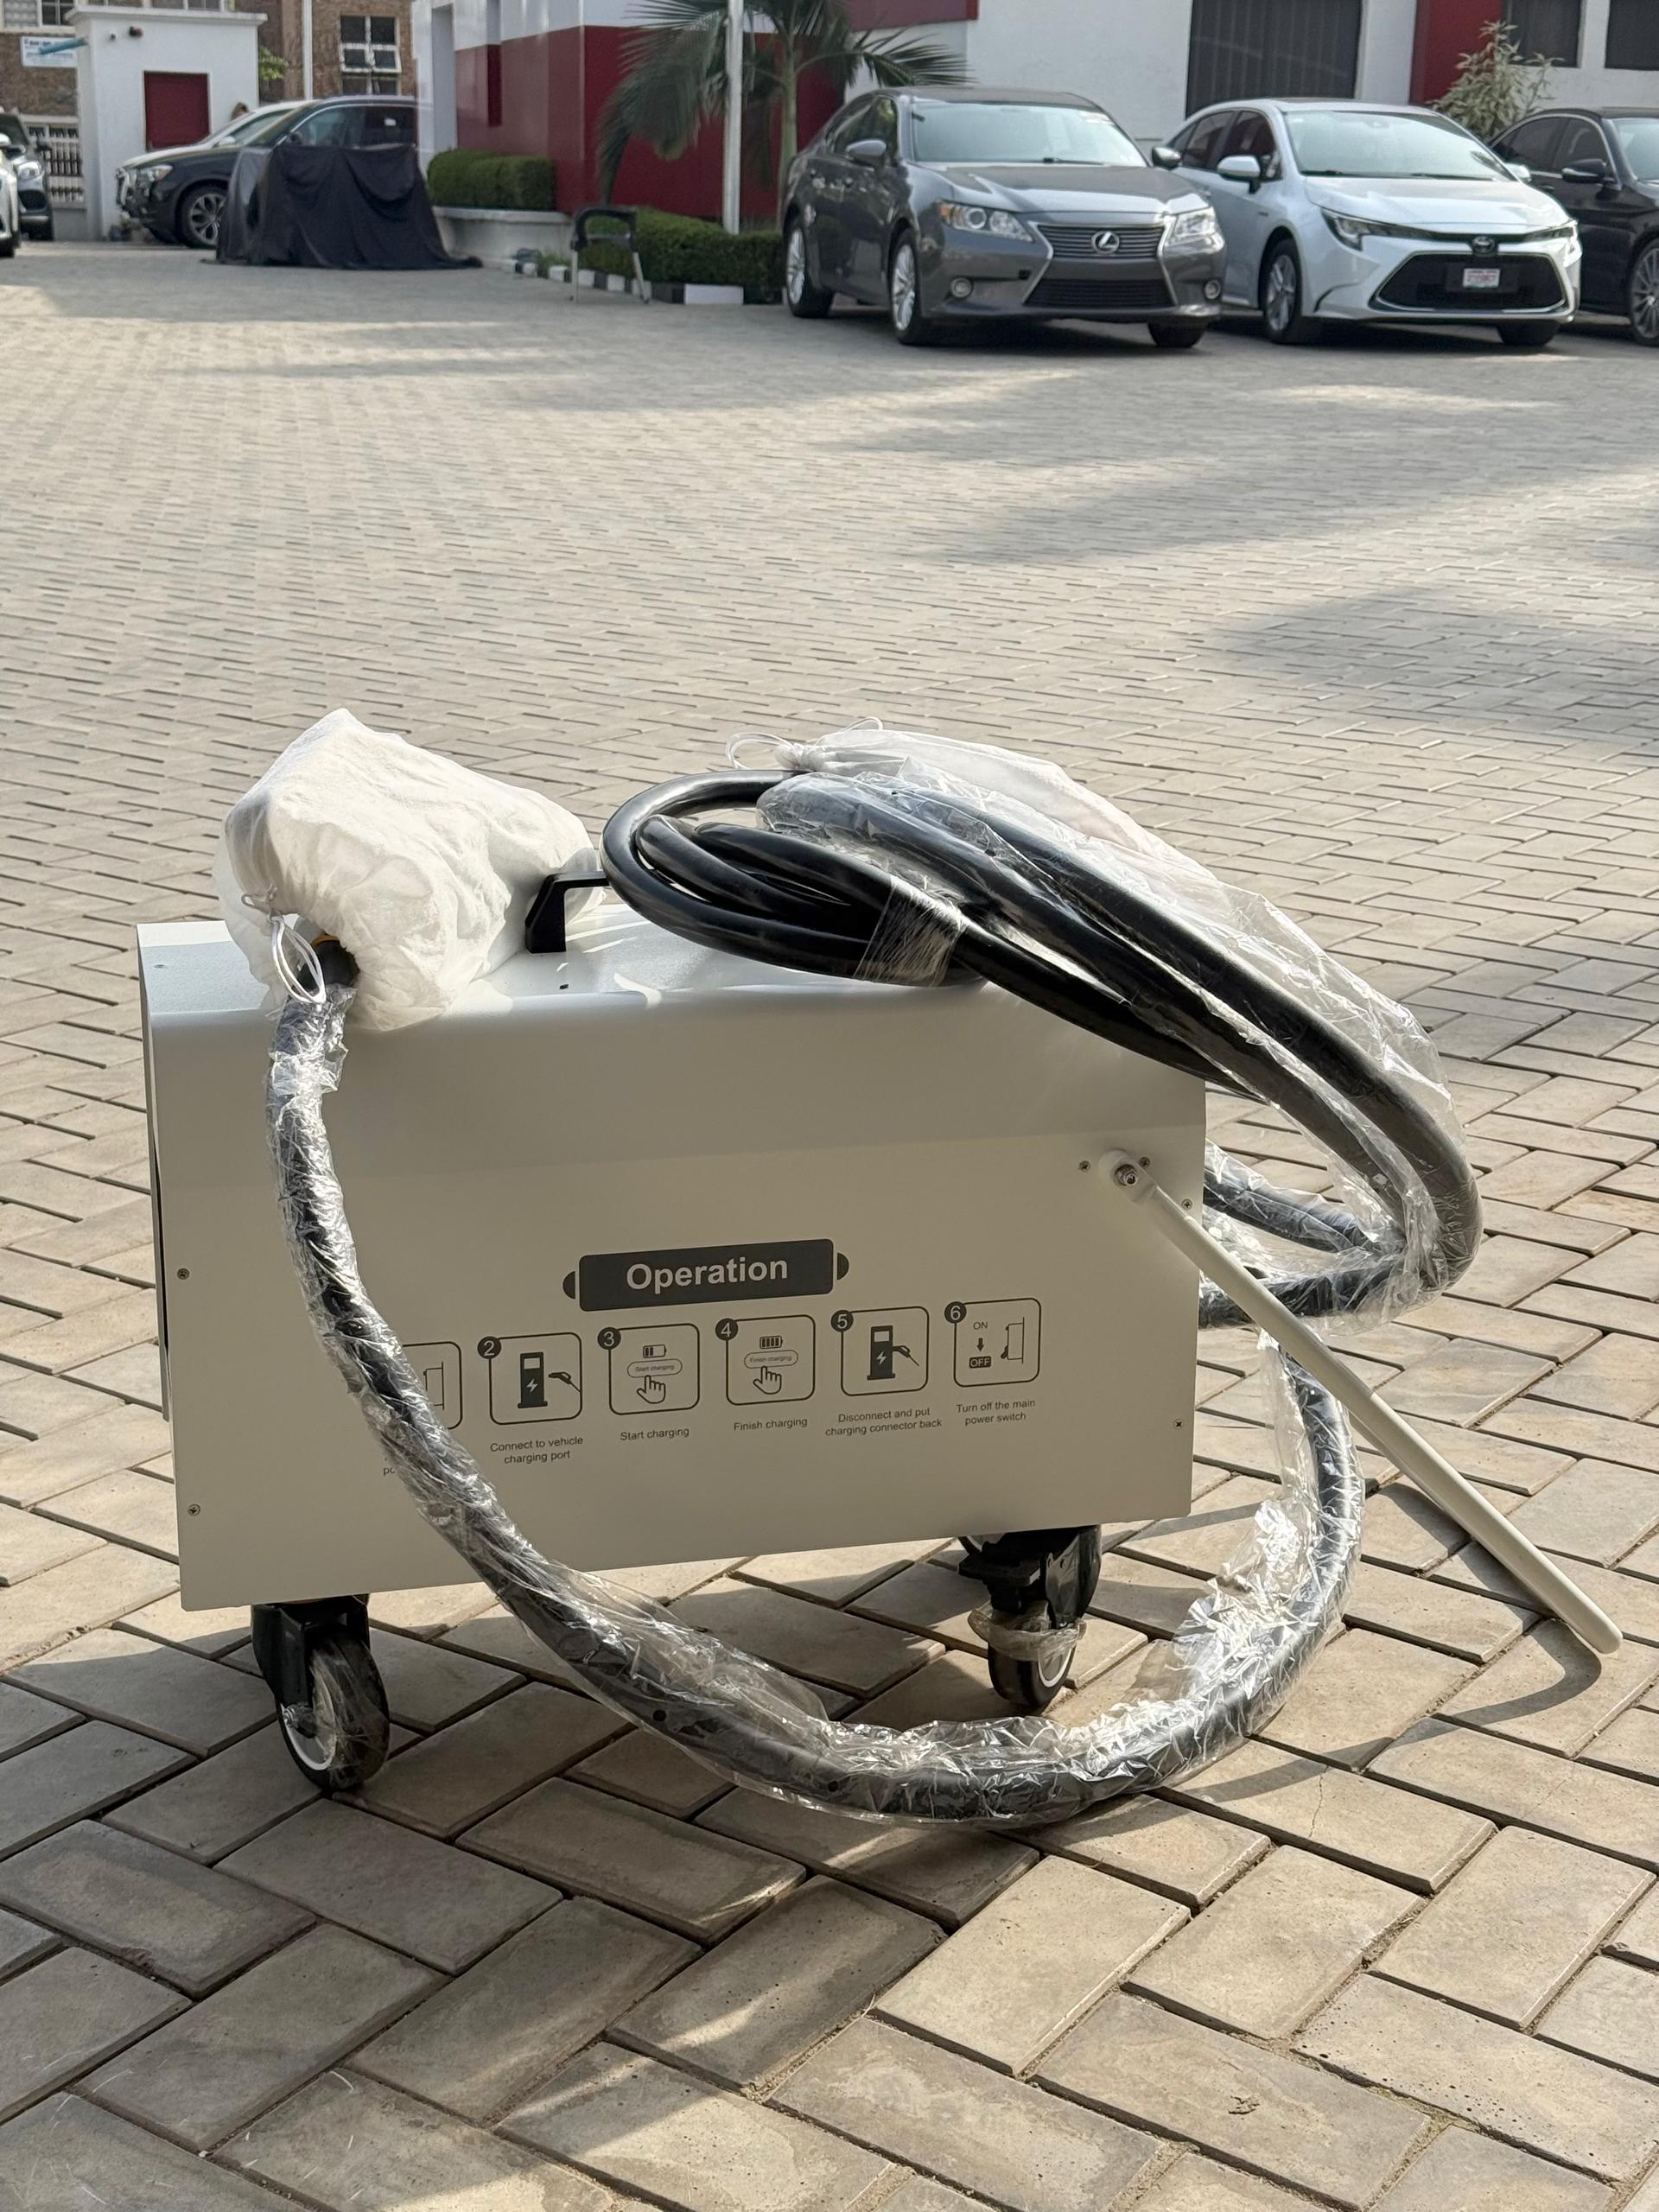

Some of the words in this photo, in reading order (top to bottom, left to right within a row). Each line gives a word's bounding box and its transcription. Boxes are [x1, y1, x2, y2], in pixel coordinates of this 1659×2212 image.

[626, 1256, 788, 1294] Operation
[950, 1305, 962, 1321] 6
[836, 1313, 849, 1330] 5
[973, 1321, 988, 1331] ON
[720, 1322, 732, 1338] 4
[603, 1331, 615, 1347] 3
[483, 1340, 495, 1357] 2
[969, 1357, 991, 1368] OFF
[957, 1403, 978, 1414] Turn
[980, 1402, 993, 1411] off
[995, 1401, 1010, 1410] the
[1012, 1399, 1036, 1408] main
[838, 1410, 892, 1423] Disconnect
[894, 1408, 912, 1418] and
[915, 1407, 931, 1419] put
[965, 1414, 995, 1427] power
[997, 1412, 1027, 1422] switch
[734, 1420, 763, 1431] Finish
[766, 1418, 808, 1429] charging
[825, 1425, 868, 1437] charging
[869, 1421, 917, 1433] connector
[919, 1419, 943, 1428] back
[620, 1431, 644, 1441] Start
[646, 1428, 690, 1439] charging
[490, 1440, 533, 1452] Connect
[536, 1440, 546, 1448] to
[548, 1436, 583, 1447] vehicle
[504, 1452, 548, 1465] charging
[550, 1450, 571, 1463] port
